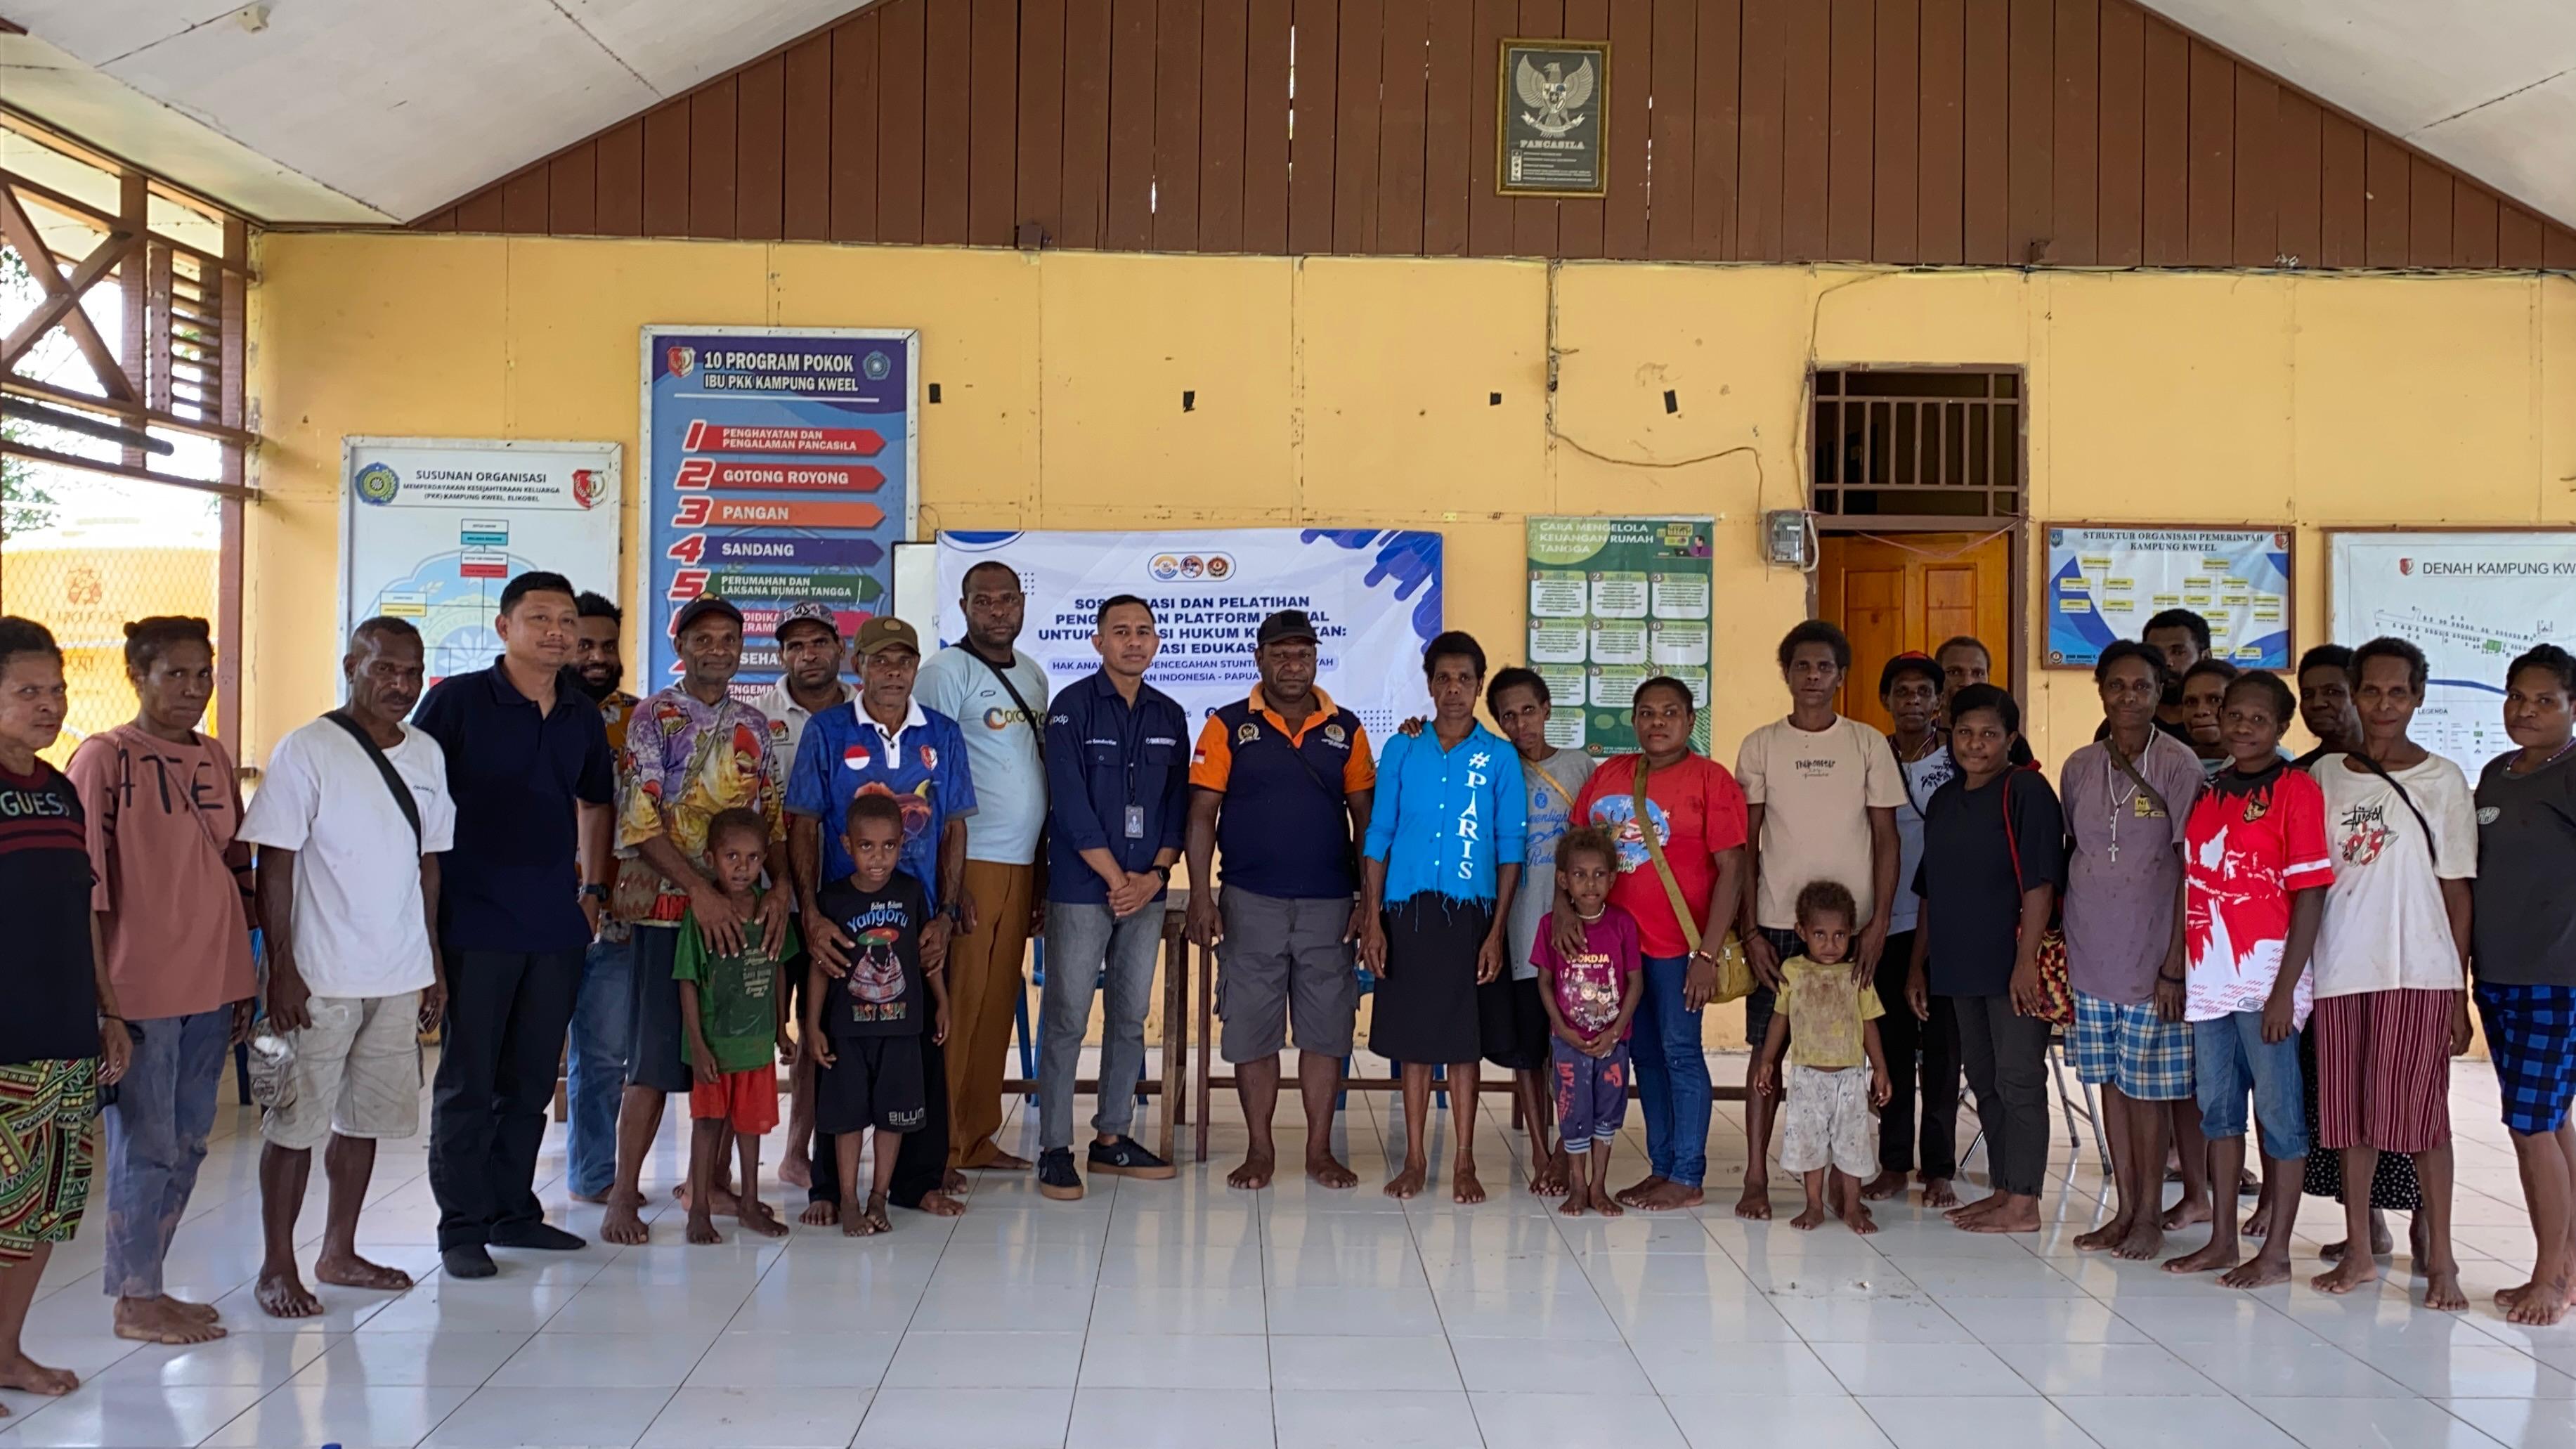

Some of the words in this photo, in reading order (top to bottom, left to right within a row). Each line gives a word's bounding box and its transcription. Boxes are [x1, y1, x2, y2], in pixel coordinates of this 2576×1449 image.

[1520, 140, 1585, 150] PANCASILA
[704, 351, 722, 369] 10
[726, 352, 799, 371] PROGRAM
[803, 355, 854, 372] POKOK
[705, 374, 725, 389] IBU
[727, 375, 753, 389] PKK
[755, 375, 815, 391] KAMPUNG
[818, 377, 859, 392] KWEEL
[722, 429, 798, 439] PENGHAYATAN
[800, 429, 823, 440] DAN
[722, 438, 797, 450] PENGALAMAN
[798, 440, 857, 450] PANCASILA
[416, 470, 472, 481] SUSUNAN
[476, 472, 547, 483] ORGANISASI
[674, 458, 715, 490] 2
[723, 469, 783, 483] GOTONG
[787, 471, 849, 484] ROYONG
[671, 495, 714, 528] 3
[722, 506, 789, 520] PANGAN
[1540, 522, 1573, 531] CARA
[1576, 523, 1648, 533] MENGELOLA
[1540, 534, 1607, 543] KEUANGAN
[1610, 535, 1653, 543] RUMAH
[2083, 531, 2135, 540] STRUKTUR
[2138, 532, 2197, 541] ORGANISASI
[2199, 533, 2263, 542] PEMERINTAH
[666, 533, 707, 566] 4
[722, 542, 794, 557] SANDANG
[1540, 545, 1591, 554] TANGGA
[2131, 542, 2179, 552] KAMPUNG
[2183, 542, 2218, 552] KWEEL
[2423, 563, 2472, 574] DENAH
[2478, 563, 2549, 574] KAMPUNG
[721, 576, 786, 586] PERUMAHAN
[789, 576, 810, 586] DAN
[721, 585, 769, 595] LAKSANA
[771, 586, 808, 596] RUMAH
[811, 587, 851, 597] TANGGA
[1180, 598, 1214, 609] DAN
[1219, 596, 1309, 609] PELATIHAN
[1174, 612, 1260, 624] PLATFORM
[1039, 629, 1095, 640] UNTUK
[1179, 628, 1239, 639] HUKUM
[1191, 642, 1256, 654] EDUKAS
[1053, 661, 1075, 670] HAK
[1159, 672, 1216, 682] INDONESIA
[1225, 672, 1260, 681] PAPUA
[847, 908, 909, 933] Yangoru
